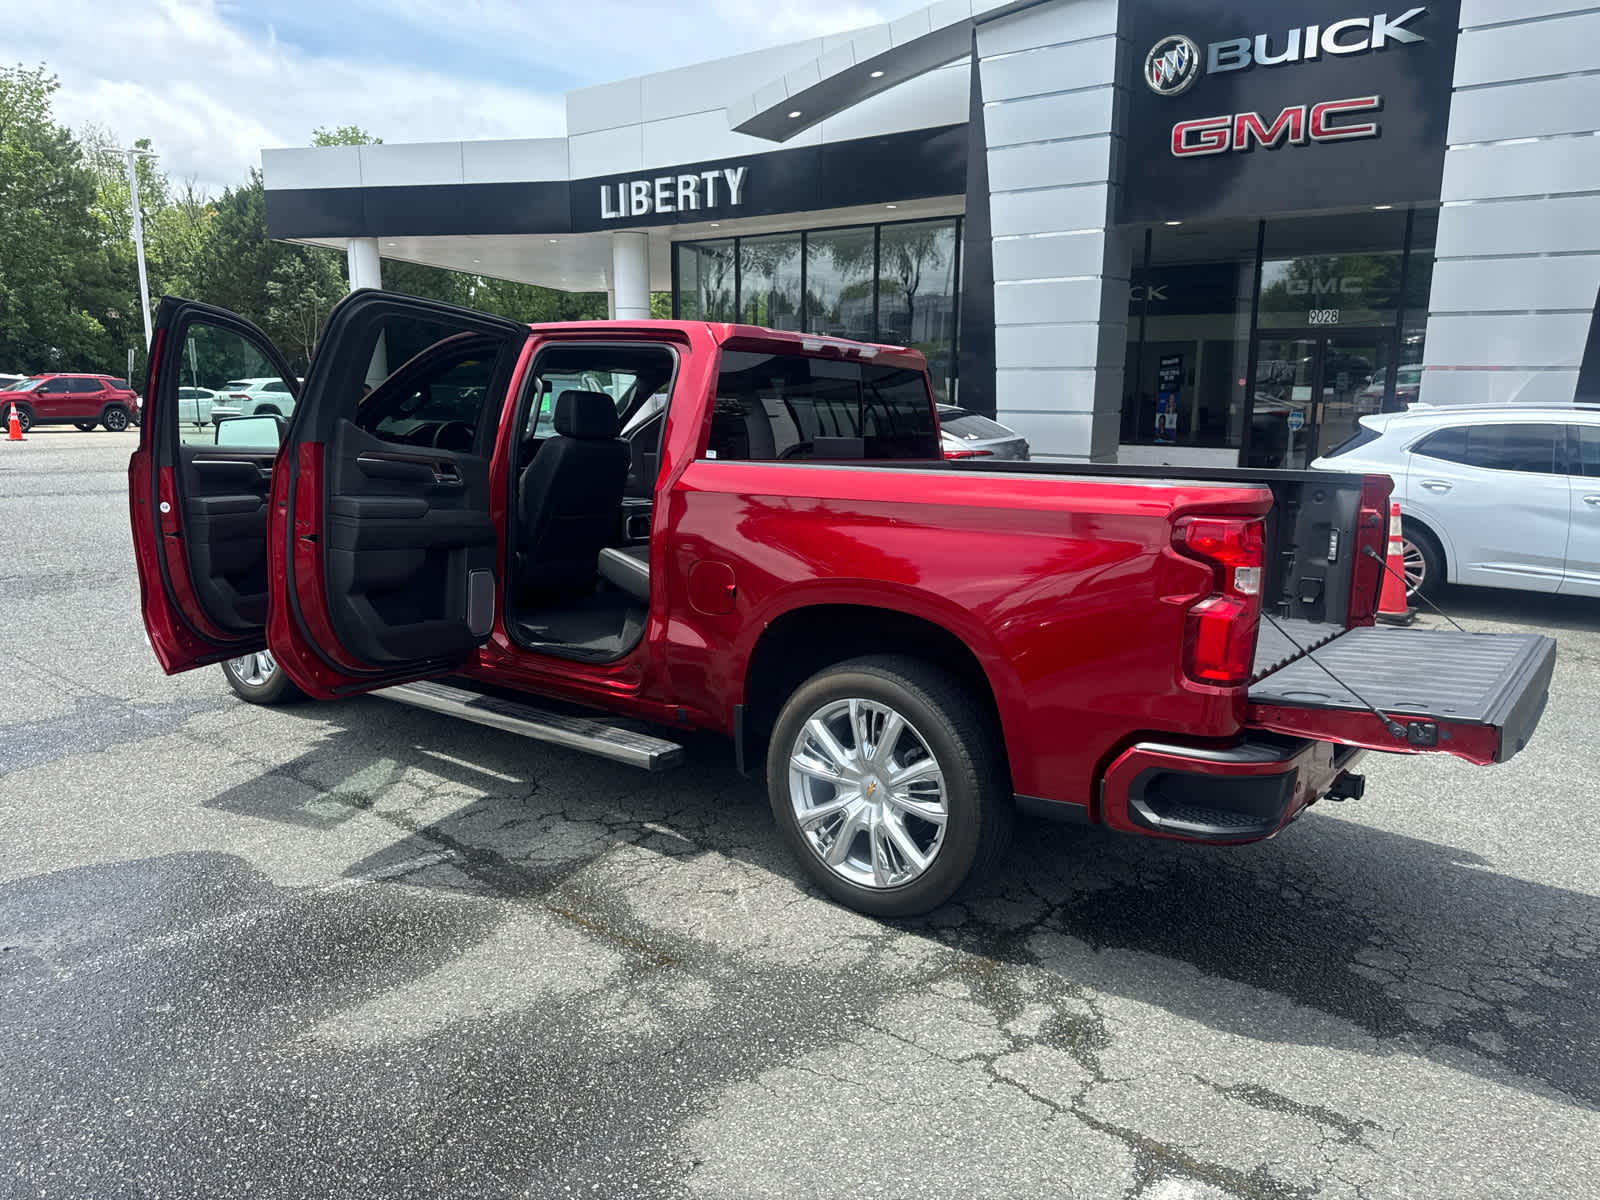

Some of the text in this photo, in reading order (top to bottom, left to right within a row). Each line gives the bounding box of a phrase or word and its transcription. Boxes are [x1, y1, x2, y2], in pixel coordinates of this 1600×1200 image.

[1206, 7, 1426, 74] BUICK
[1171, 95, 1380, 158] GMC
[600, 166, 747, 219] LIBERTY
[1286, 277, 1363, 295] GMC
[1308, 309, 1339, 324] 9028
